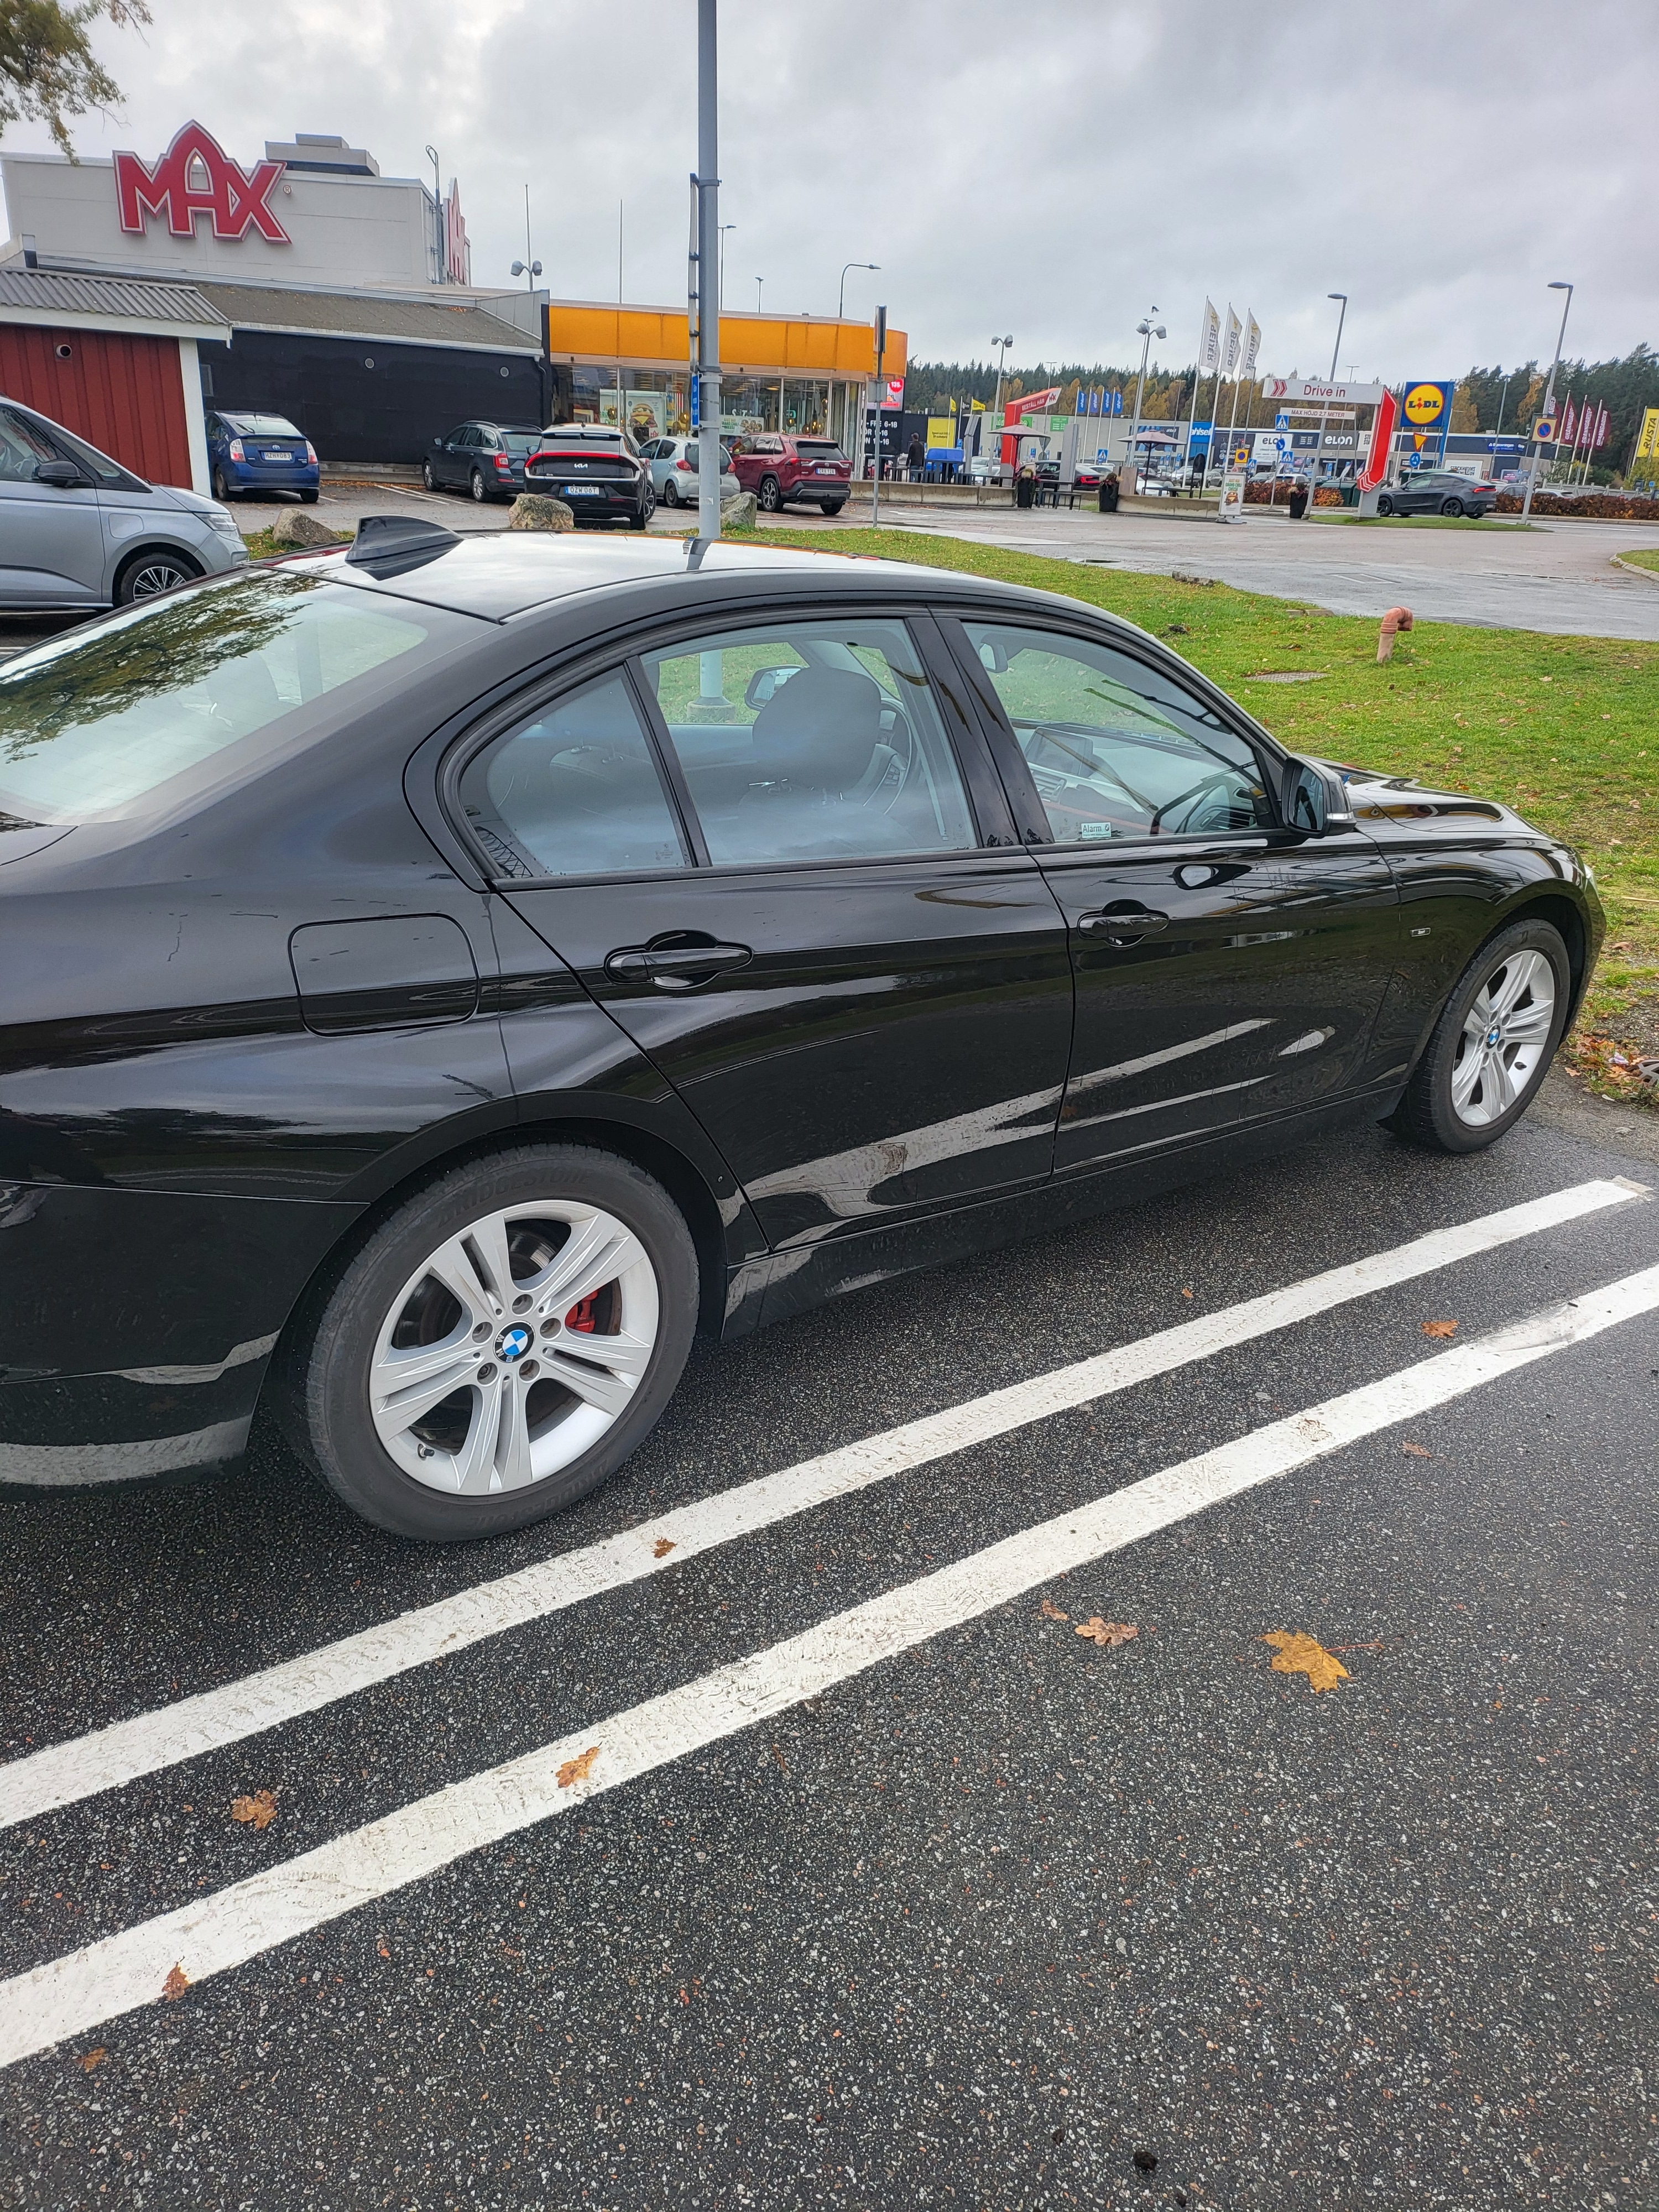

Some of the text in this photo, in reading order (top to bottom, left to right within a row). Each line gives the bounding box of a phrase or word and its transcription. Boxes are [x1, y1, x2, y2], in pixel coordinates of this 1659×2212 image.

[112, 119, 292, 243] MAX
[1303, 384, 1345, 398] Drive in
[1643, 418, 1657, 450] RUSTA
[1083, 825, 1102, 833] Alarm
[496, 1333, 514, 1362] BMW
